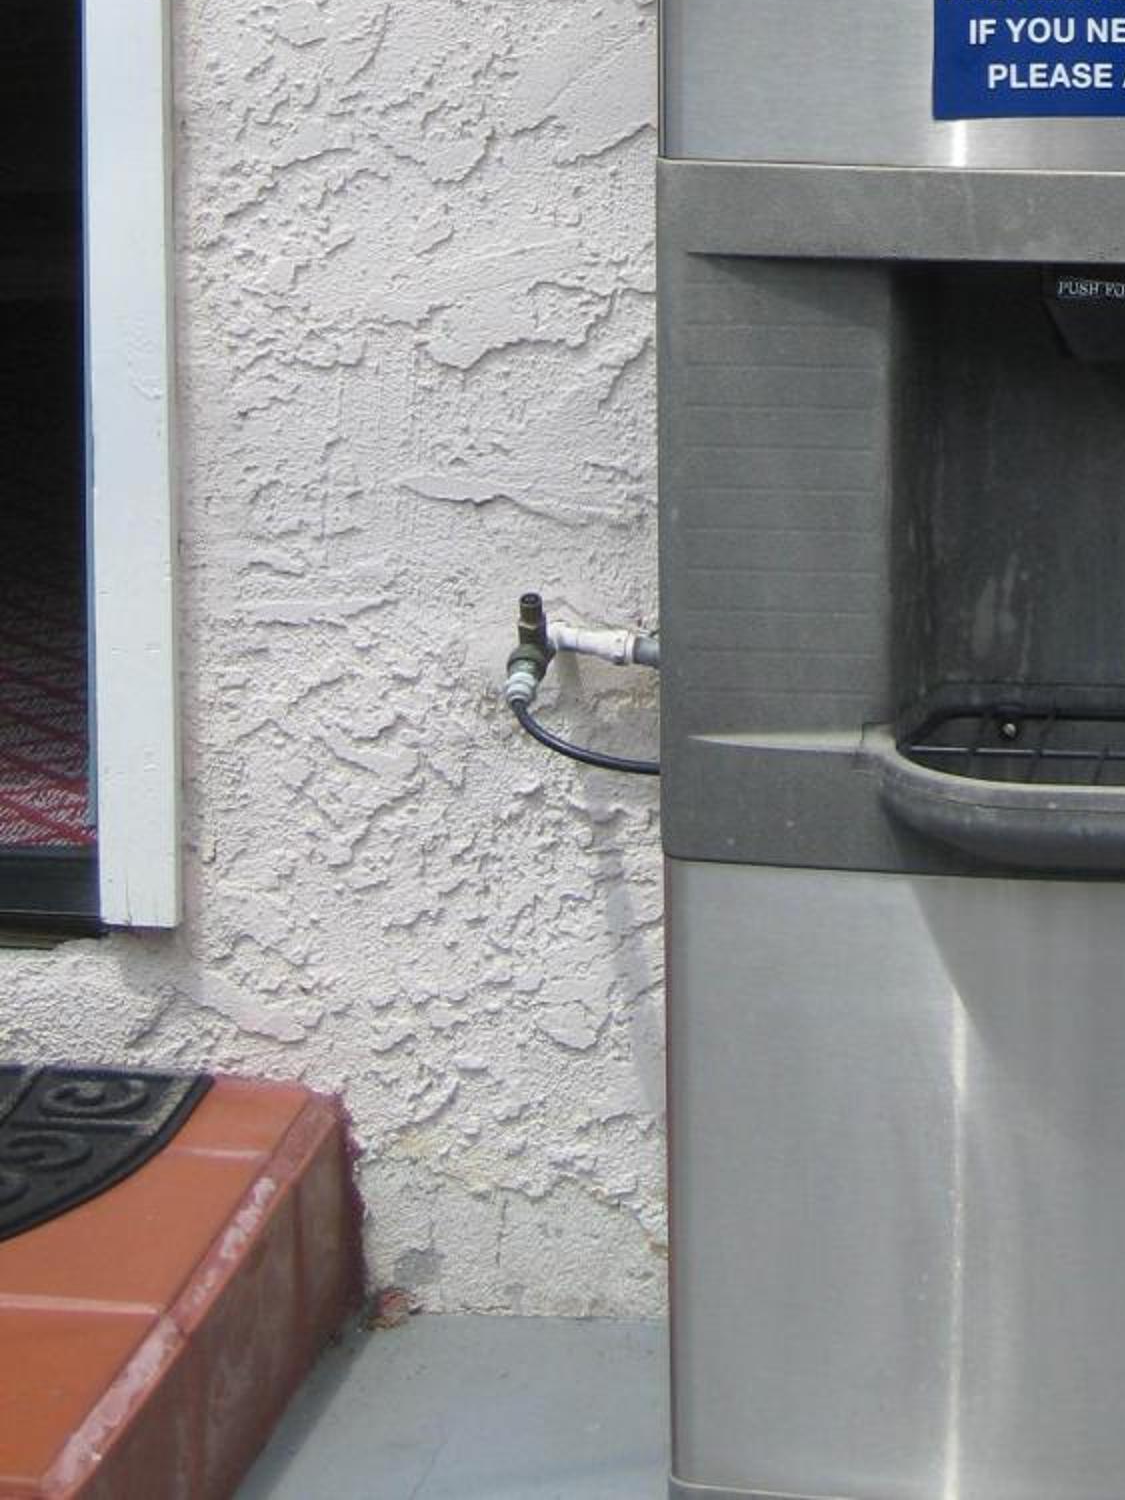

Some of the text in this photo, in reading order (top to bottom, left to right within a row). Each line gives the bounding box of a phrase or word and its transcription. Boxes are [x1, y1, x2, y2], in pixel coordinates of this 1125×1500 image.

[968, 19, 997, 45] IF
[1005, 17, 1075, 44] YOU
[987, 63, 1113, 90] PLEASE
[1058, 281, 1099, 296] PUSH
